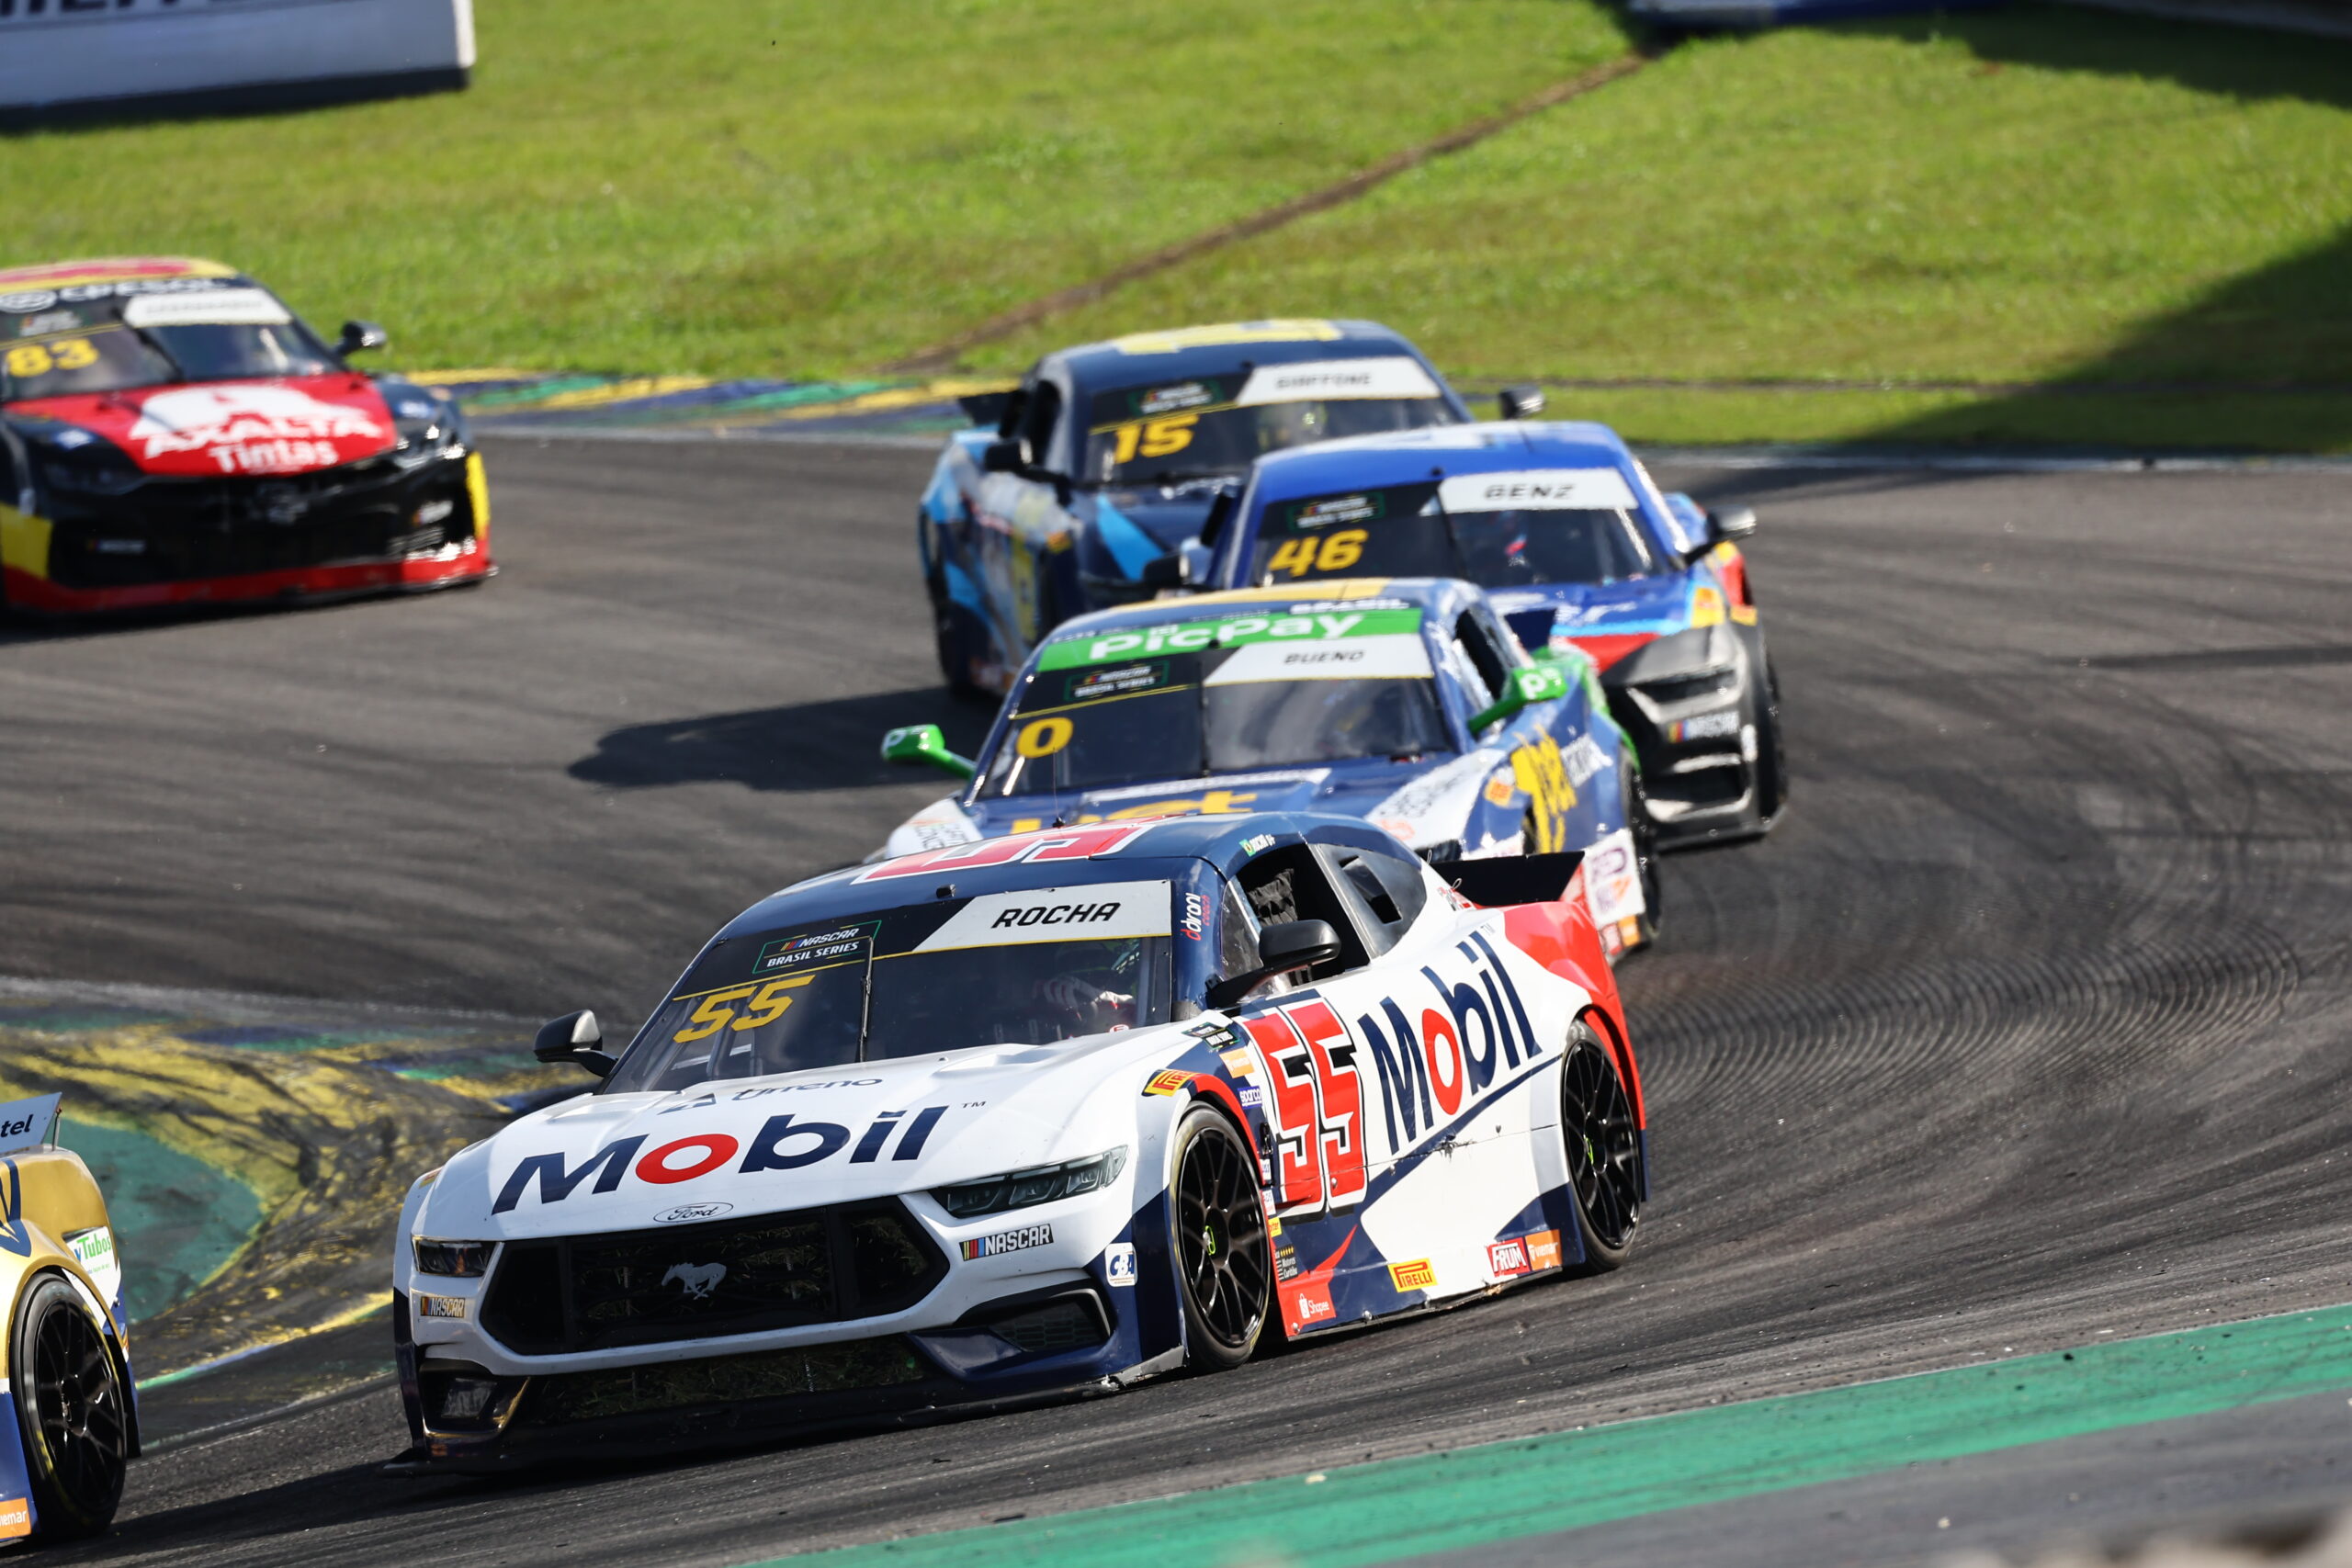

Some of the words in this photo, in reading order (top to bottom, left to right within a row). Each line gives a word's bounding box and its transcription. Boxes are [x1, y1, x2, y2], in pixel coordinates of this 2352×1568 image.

[6, 338, 99, 378] 83
[1113, 412, 1200, 464] 15
[207, 439, 339, 473] Tintas
[1485, 483, 1577, 500] GENZ
[1268, 529, 1370, 577] 46
[1284, 649, 1365, 664] BUENO
[990, 902, 1121, 929] ROCHA
[798, 928, 860, 948] NASCAR
[766, 951, 811, 968] BRASIL
[814, 942, 860, 958] SERIES
[673, 975, 816, 1043] 55
[1357, 931, 1543, 1156] Mobil
[961, 1100, 987, 1109] TM
[1239, 1088, 1262, 1103] sparco
[1239, 1001, 1367, 1208] 55
[0, 1114, 34, 1138] tel
[492, 1105, 950, 1215] Mobil
[667, 1205, 718, 1221] Ford
[984, 1224, 1051, 1256] NASCAR
[1109, 1253, 1136, 1277] CBA
[1492, 1242, 1528, 1273] FRUM
[1393, 1261, 1433, 1288] PIRELLI
[429, 1297, 465, 1317] NASCAR
[1307, 1299, 1330, 1316] Shopee
